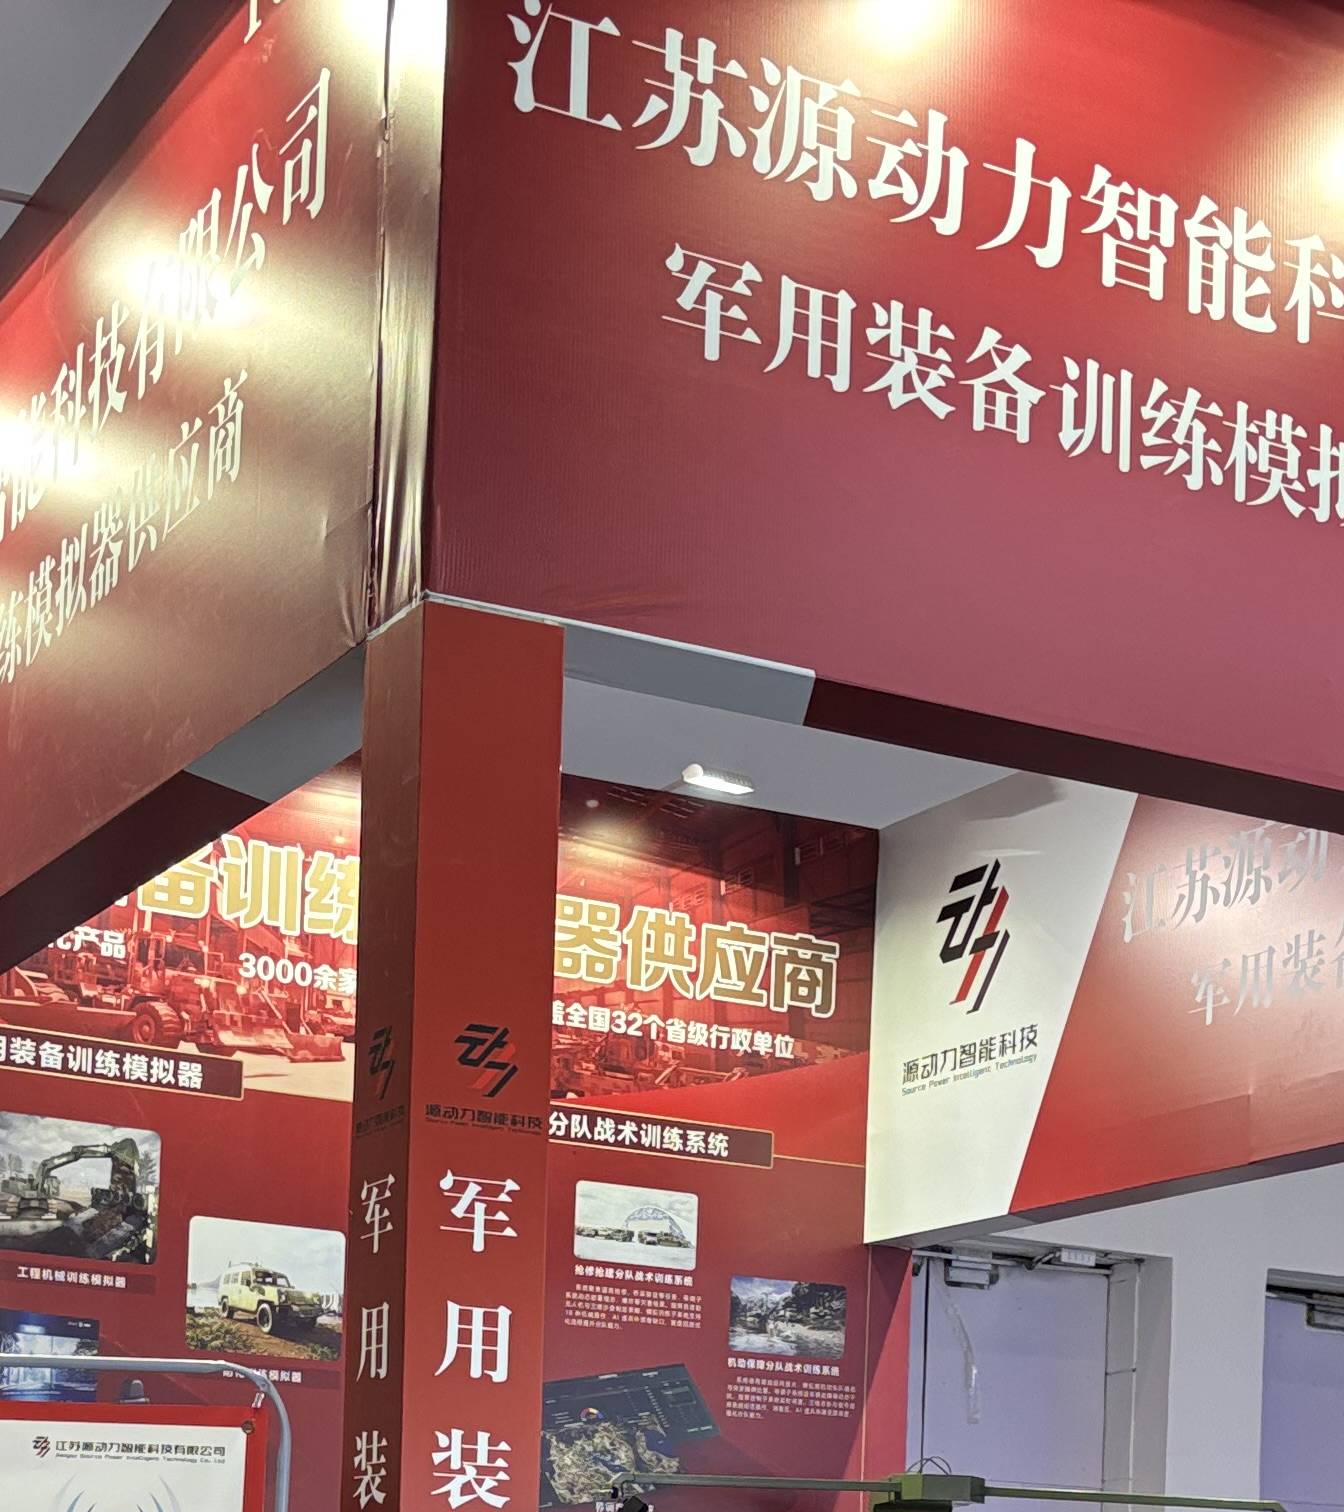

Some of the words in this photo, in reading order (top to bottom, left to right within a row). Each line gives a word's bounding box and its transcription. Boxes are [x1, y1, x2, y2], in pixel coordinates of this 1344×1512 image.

[902, 1023, 1039, 1086] 源动力智能科技
[548, 1111, 729, 1157] 分队战术训练系统
[17, 1265, 127, 1289] 工程机械训练模拟器
